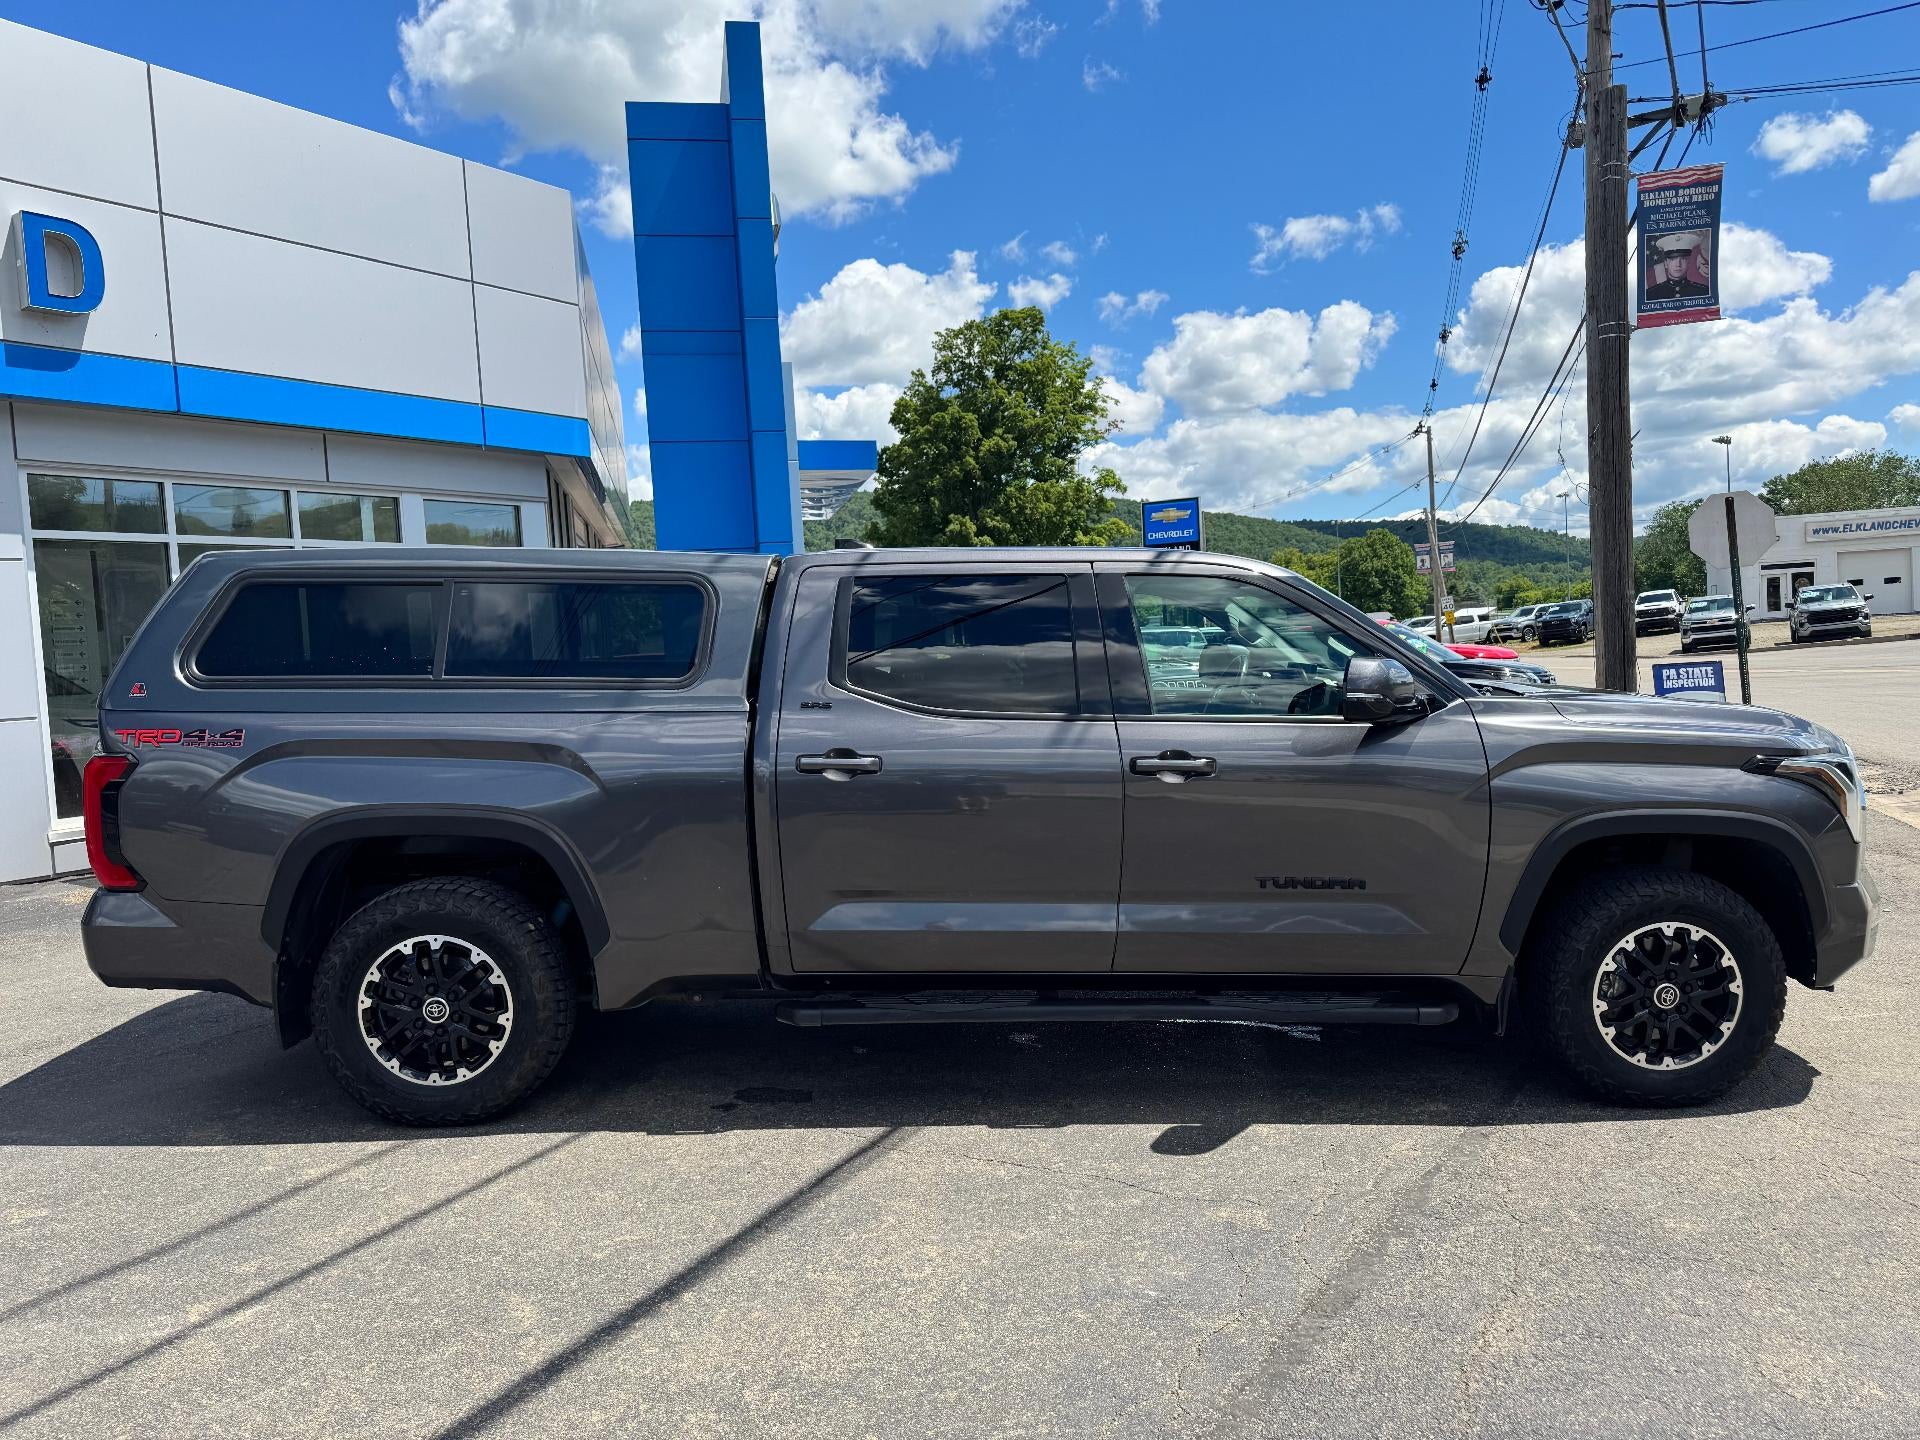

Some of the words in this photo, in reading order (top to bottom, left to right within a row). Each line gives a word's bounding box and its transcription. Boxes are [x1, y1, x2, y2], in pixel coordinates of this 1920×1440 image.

[1640, 190, 1676, 201] ELKLAND
[1678, 184, 1719, 196] BOROUGH
[1643, 196, 1690, 207] HOMETOWN
[1692, 193, 1715, 202] HERO
[1650, 211, 1683, 221] MICHAEL
[1659, 220, 1687, 229] MARINE
[1687, 217, 1712, 226] CORPS
[19, 209, 106, 314] D
[1147, 529, 1194, 540] CHEVROLET
[1662, 668, 1678, 680] PA
[1680, 666, 1714, 680] STATE
[1663, 677, 1715, 689] INSPECTION
[115, 728, 183, 748] TRD
[1255, 876, 1367, 890] TUNDRA
